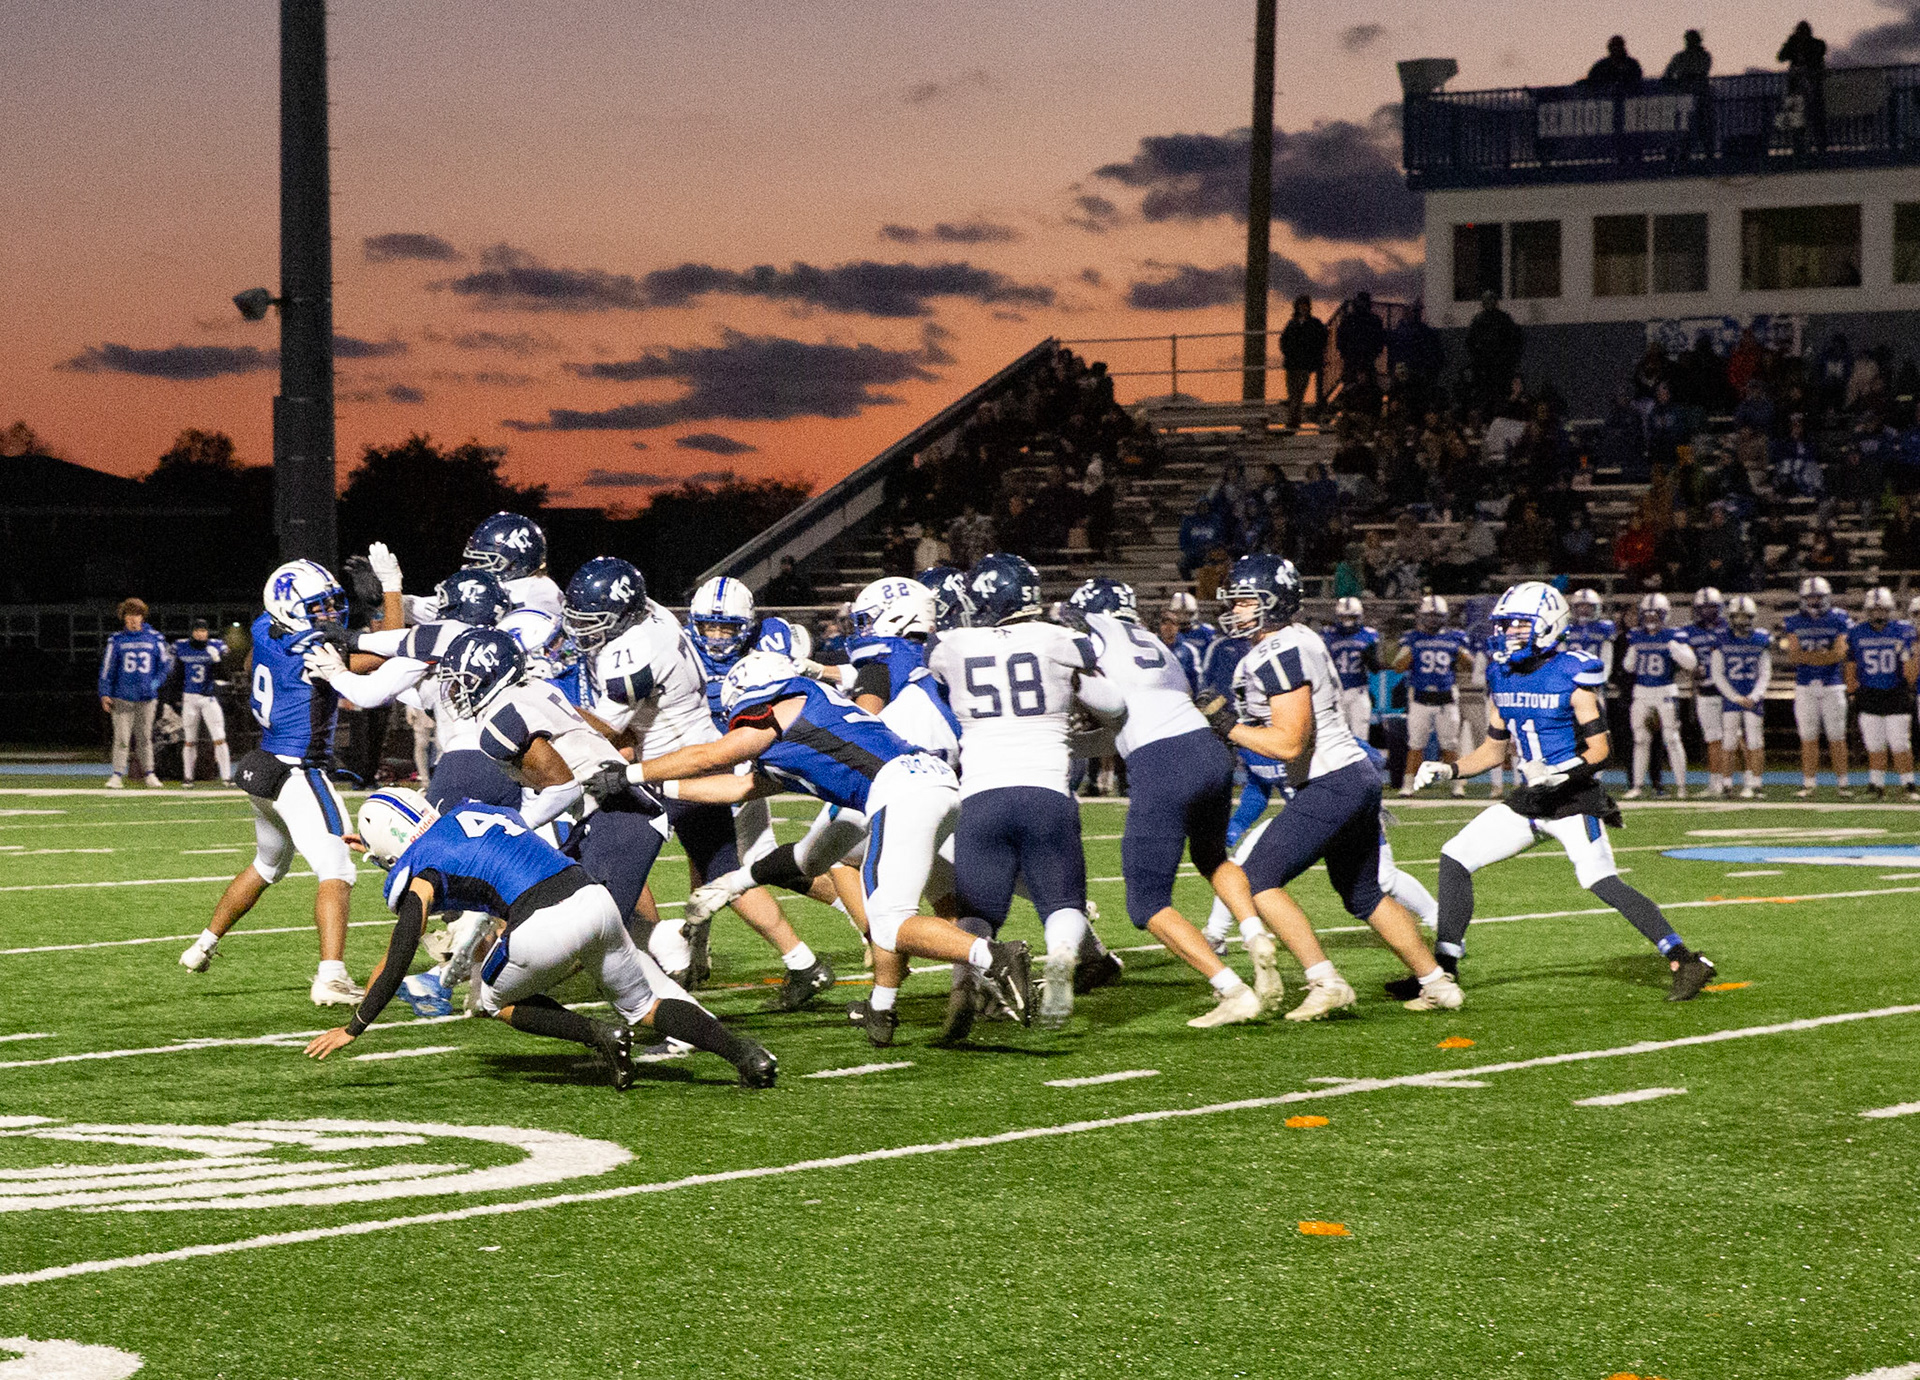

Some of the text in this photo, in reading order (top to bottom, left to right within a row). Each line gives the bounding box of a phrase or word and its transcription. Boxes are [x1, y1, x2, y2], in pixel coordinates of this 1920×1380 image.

[1538, 94, 1694, 138] SENIOR NIGHT
[882, 582, 911, 599] 22
[123, 651, 152, 674] 63
[612, 648, 635, 669] 71
[1336, 650, 1362, 674] 42
[1420, 650, 1451, 675] 99
[1637, 654, 1665, 677] 18
[1728, 656, 1759, 680] 23
[1863, 649, 1896, 675] 50
[191, 664, 206, 684] 3
[964, 652, 1046, 719] 58
[252, 663, 274, 729] 9
[1507, 719, 1543, 762] 11
[455, 810, 527, 838] 4
